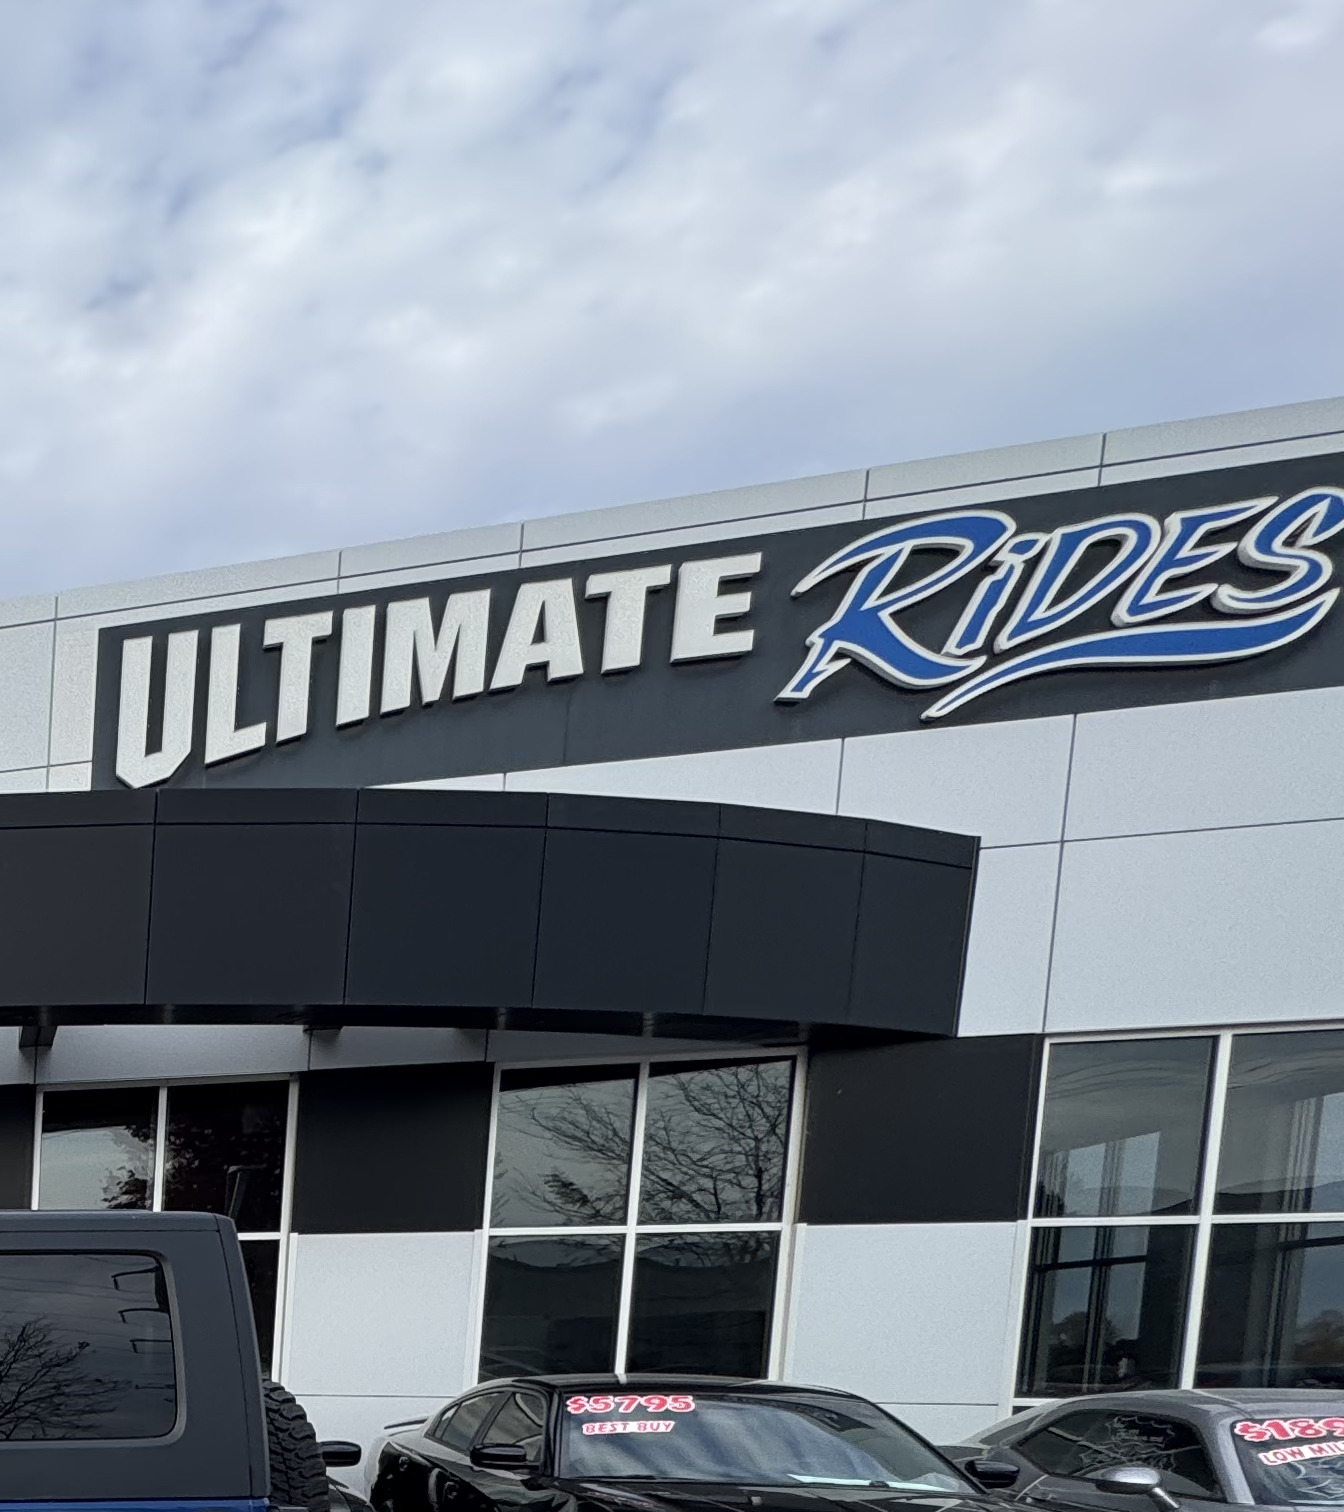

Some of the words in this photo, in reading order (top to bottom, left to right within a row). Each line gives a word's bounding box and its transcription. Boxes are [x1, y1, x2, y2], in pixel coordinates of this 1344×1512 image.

[115, 551, 763, 790] ULTIMATE
[566, 1395, 696, 1414] $5795
[584, 1422, 630, 1433] BEST
[636, 1422, 673, 1432] BUY
[1262, 1447, 1305, 1464] LOW
